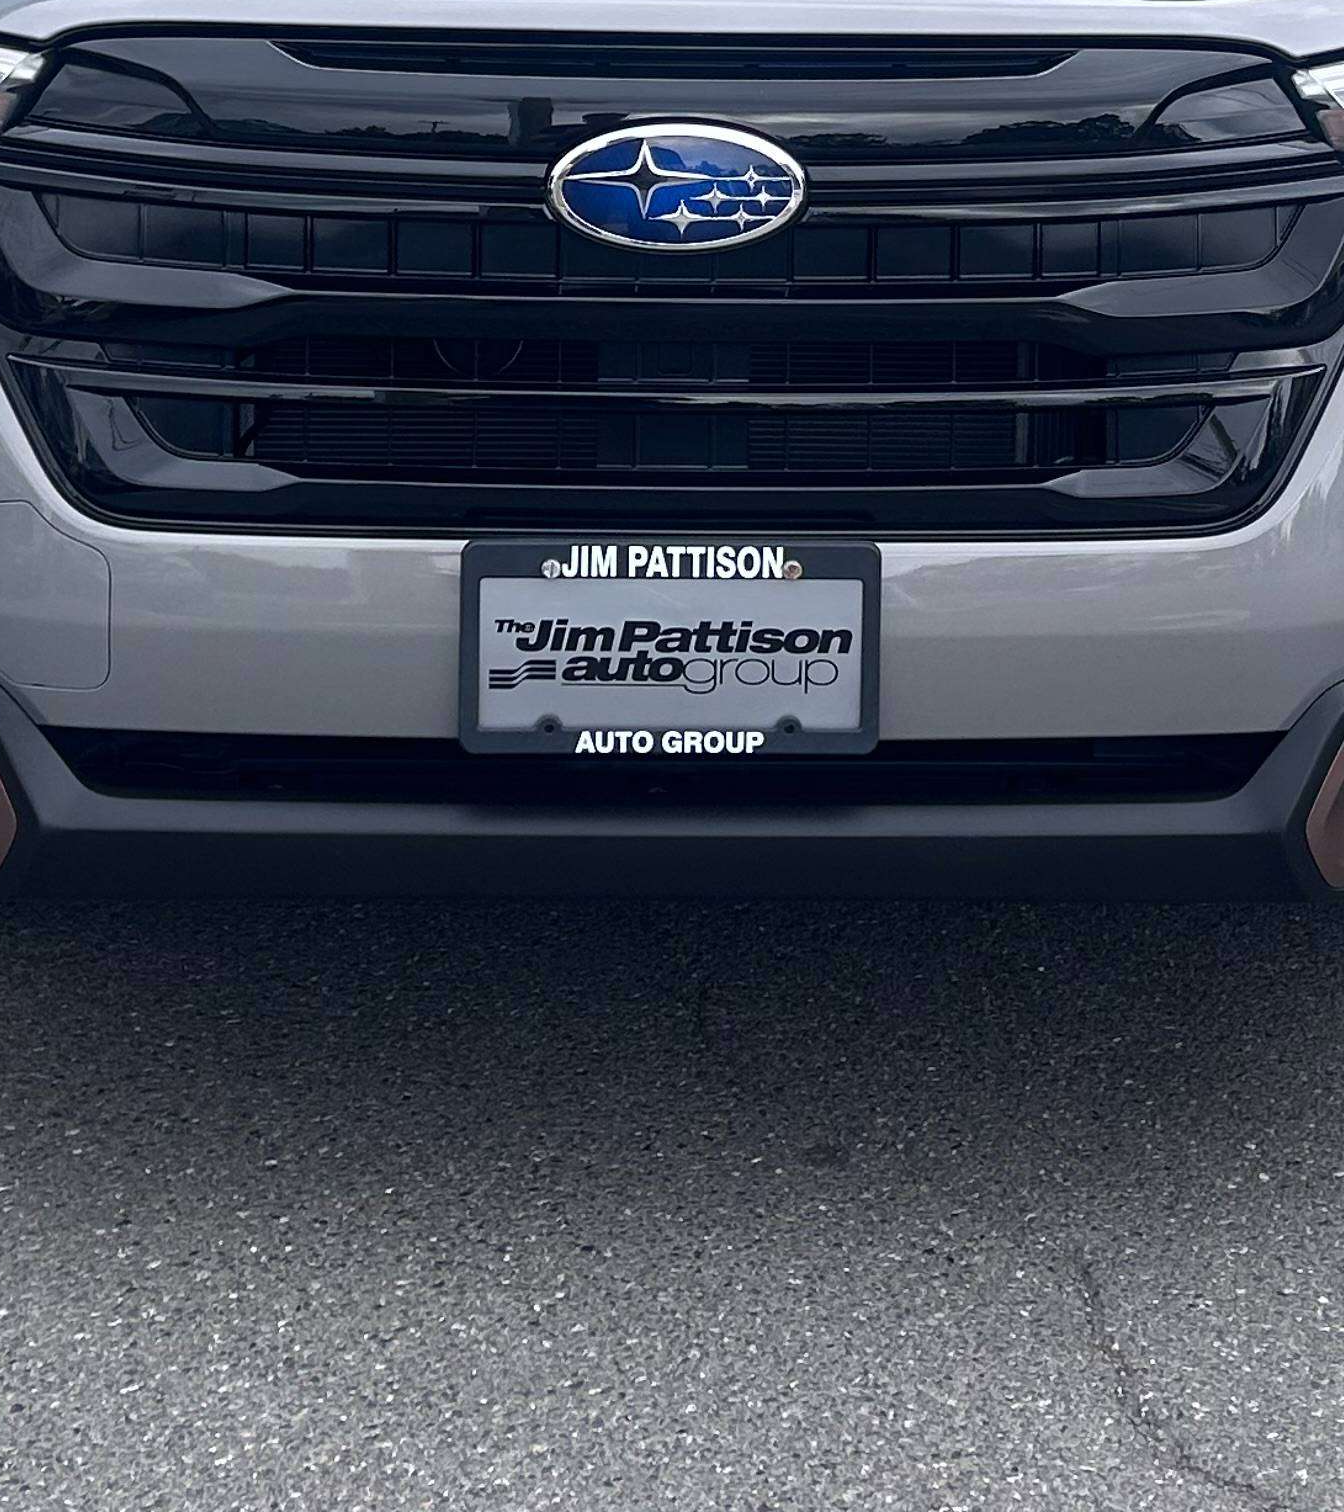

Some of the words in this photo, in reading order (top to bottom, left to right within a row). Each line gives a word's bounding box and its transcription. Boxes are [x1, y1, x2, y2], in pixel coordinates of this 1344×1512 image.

[561, 545, 616, 579] JIM
[628, 546, 784, 579] PATTISON
[495, 619, 536, 634] The
[515, 619, 612, 652] Jim
[618, 620, 853, 654] Pattison
[575, 730, 654, 754] AUTO
[661, 730, 764, 754] GROUP
